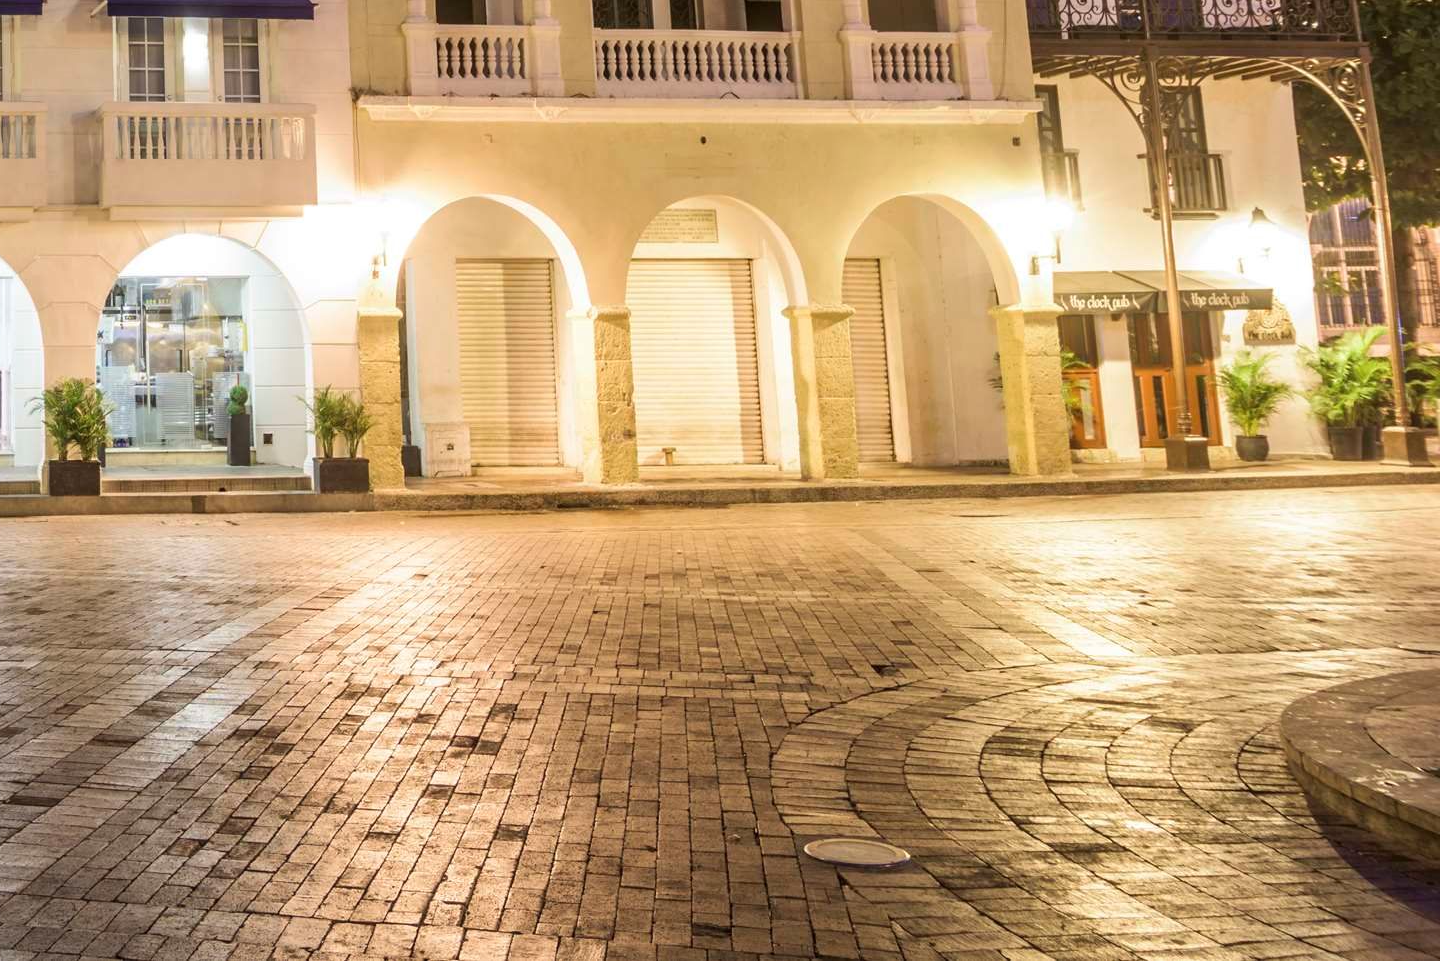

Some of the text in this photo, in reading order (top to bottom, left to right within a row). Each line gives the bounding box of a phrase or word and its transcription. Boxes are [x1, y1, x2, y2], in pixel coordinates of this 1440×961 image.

[1070, 294, 1130, 311] the clock pub
[1191, 291, 1249, 309] the clock pub
